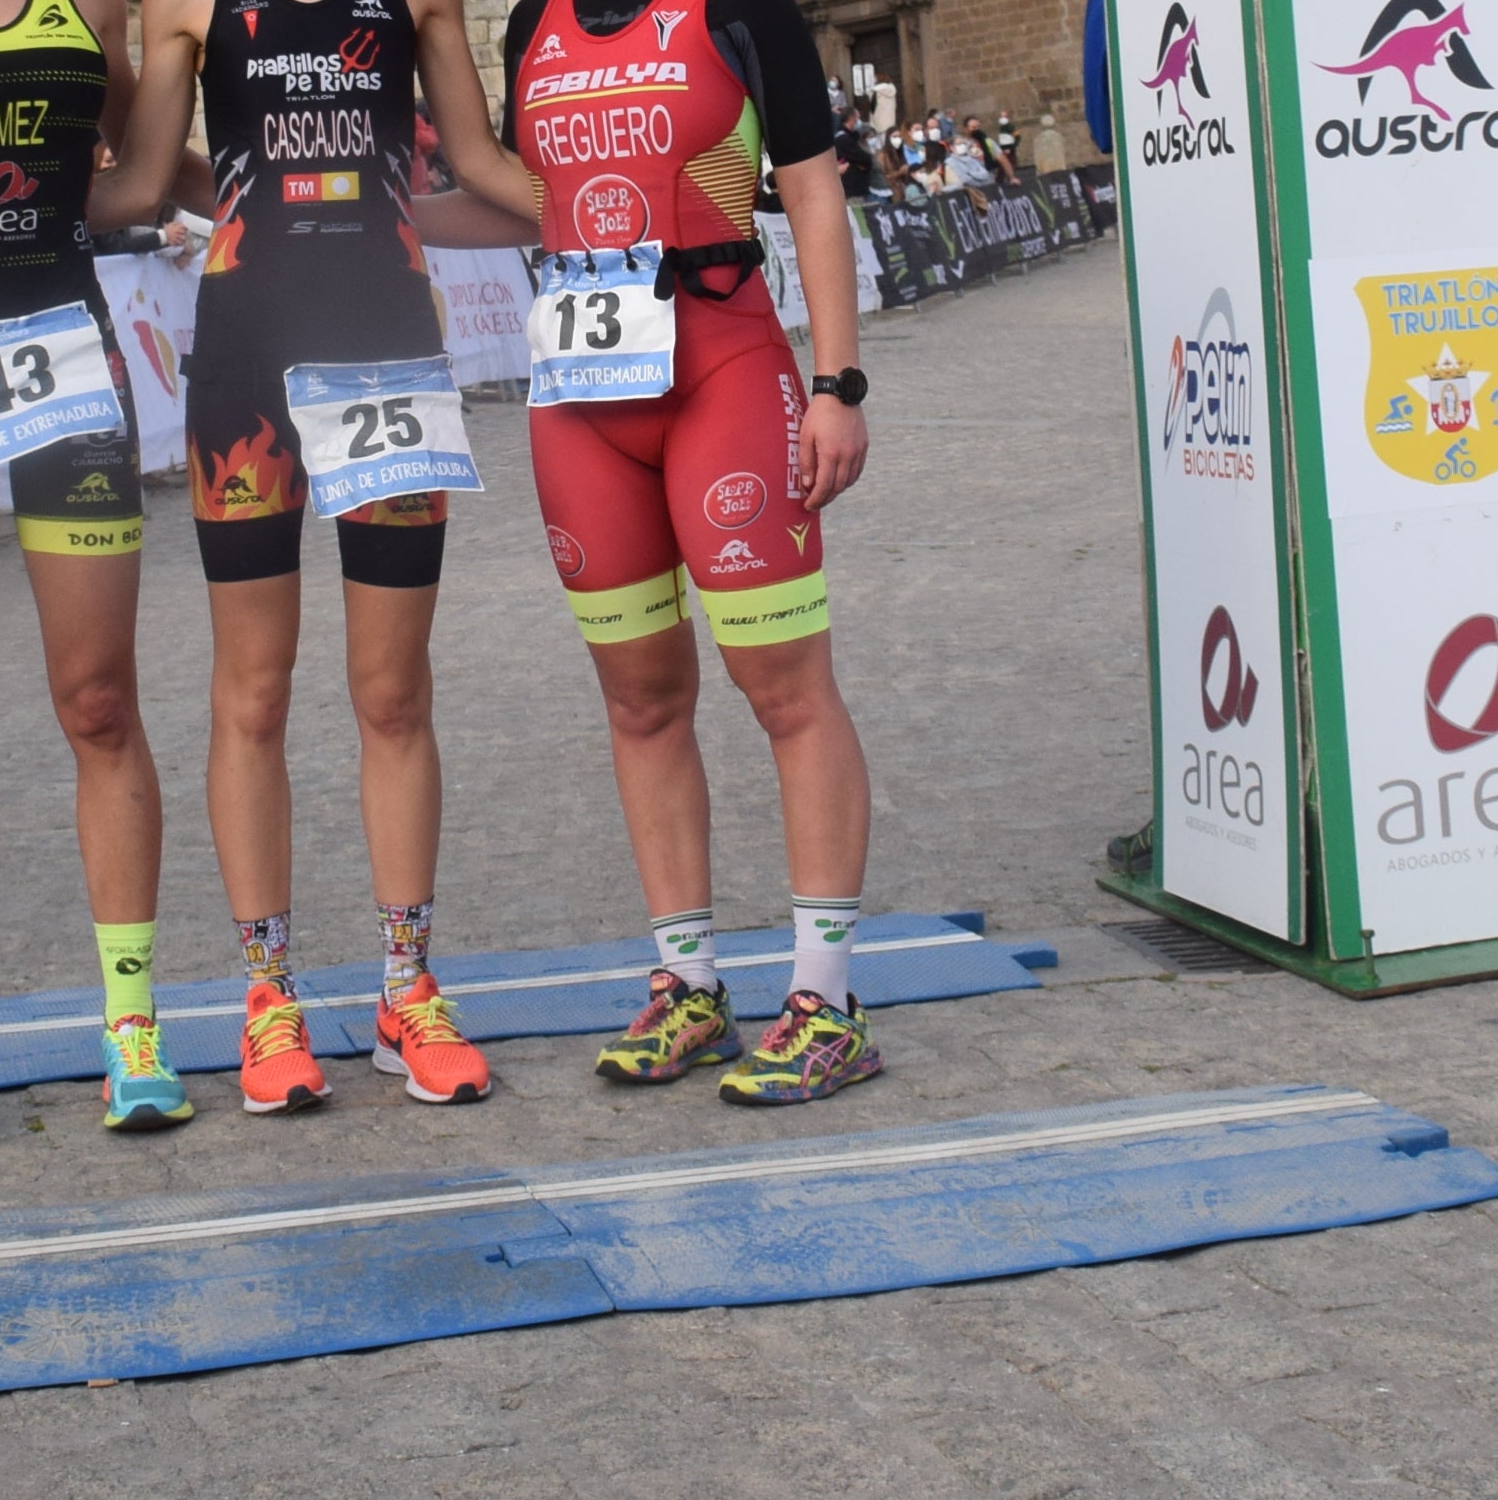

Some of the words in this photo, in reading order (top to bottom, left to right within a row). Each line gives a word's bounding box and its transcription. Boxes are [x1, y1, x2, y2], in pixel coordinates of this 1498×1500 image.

[526, 62, 688, 103] ISBILYA
[264, 109, 375, 160] CASCAJOSA
[535, 104, 672, 166] REGUERO
[1143, 116, 1235, 167] austral
[288, 181, 314, 197] TM
[556, 291, 622, 350] 13
[572, 365, 664, 386] EXTREMADURA
[14, 402, 113, 440] EXTREMADURA
[341, 398, 423, 459] 25
[317, 481, 353, 506] JUNTA
[358, 471, 374, 488] DE
[381, 461, 472, 484] EXTREMADURA
[1184, 449, 1255, 480] BICICLETAS
[68, 533, 113, 546] DON
[1183, 742, 1264, 826] area
[1388, 849, 1471, 873] ABOGADOS
[1478, 847, 1486, 860] Y
